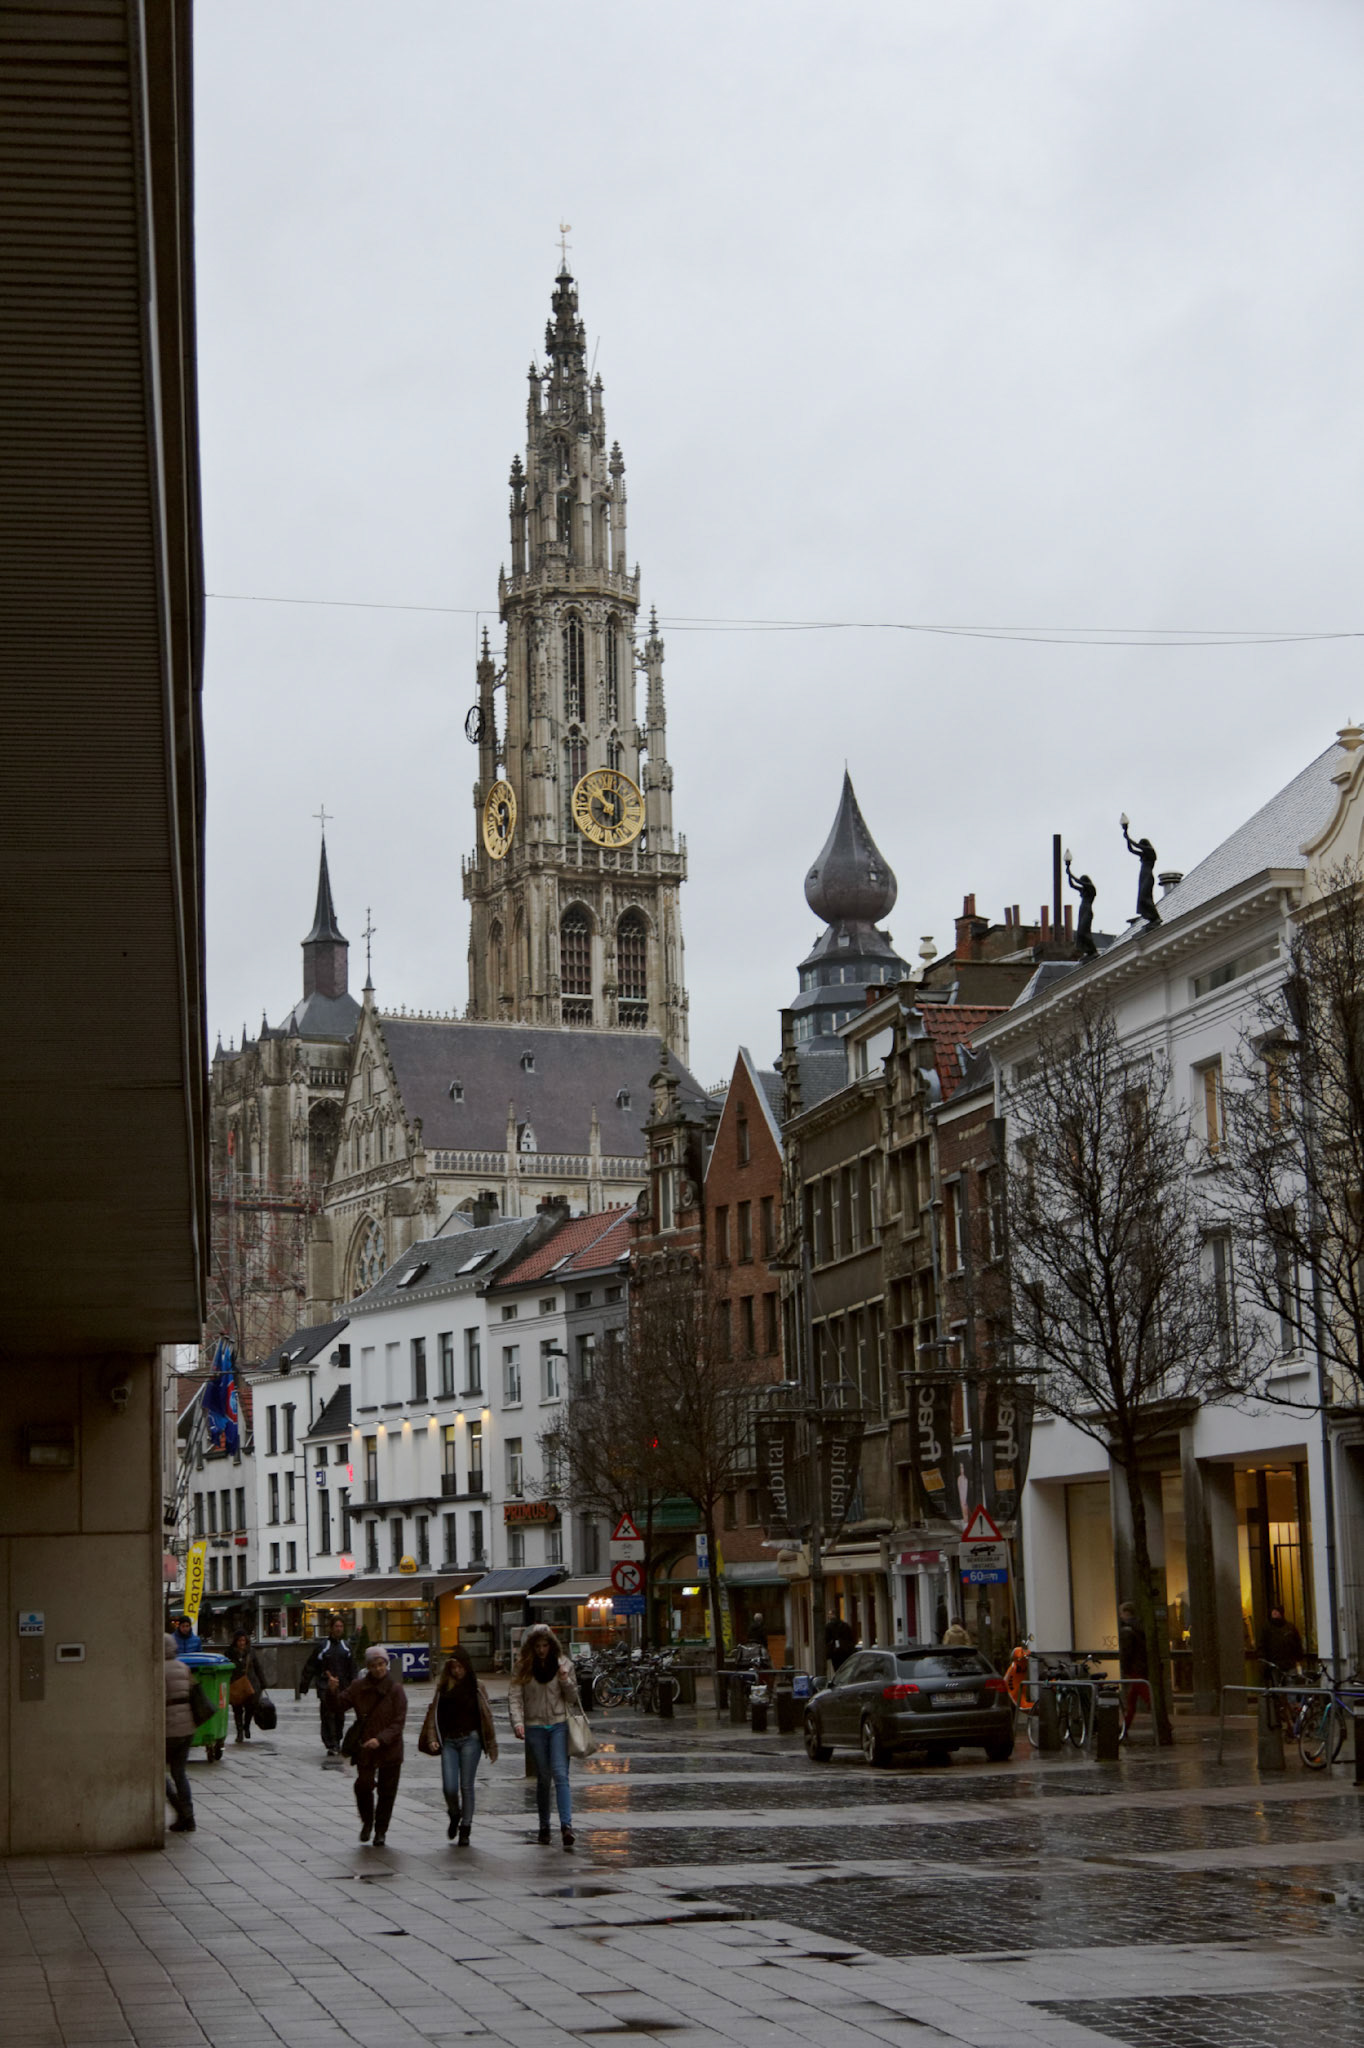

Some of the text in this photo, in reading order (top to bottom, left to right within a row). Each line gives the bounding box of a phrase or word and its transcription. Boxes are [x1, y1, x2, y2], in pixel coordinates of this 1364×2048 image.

[766, 1435, 788, 1520] habitat
[504, 1503, 547, 1520] PRIMUS
[187, 1556, 202, 1614] Panos
[970, 1571, 984, 1582] 60
[402, 1652, 415, 1673] P
